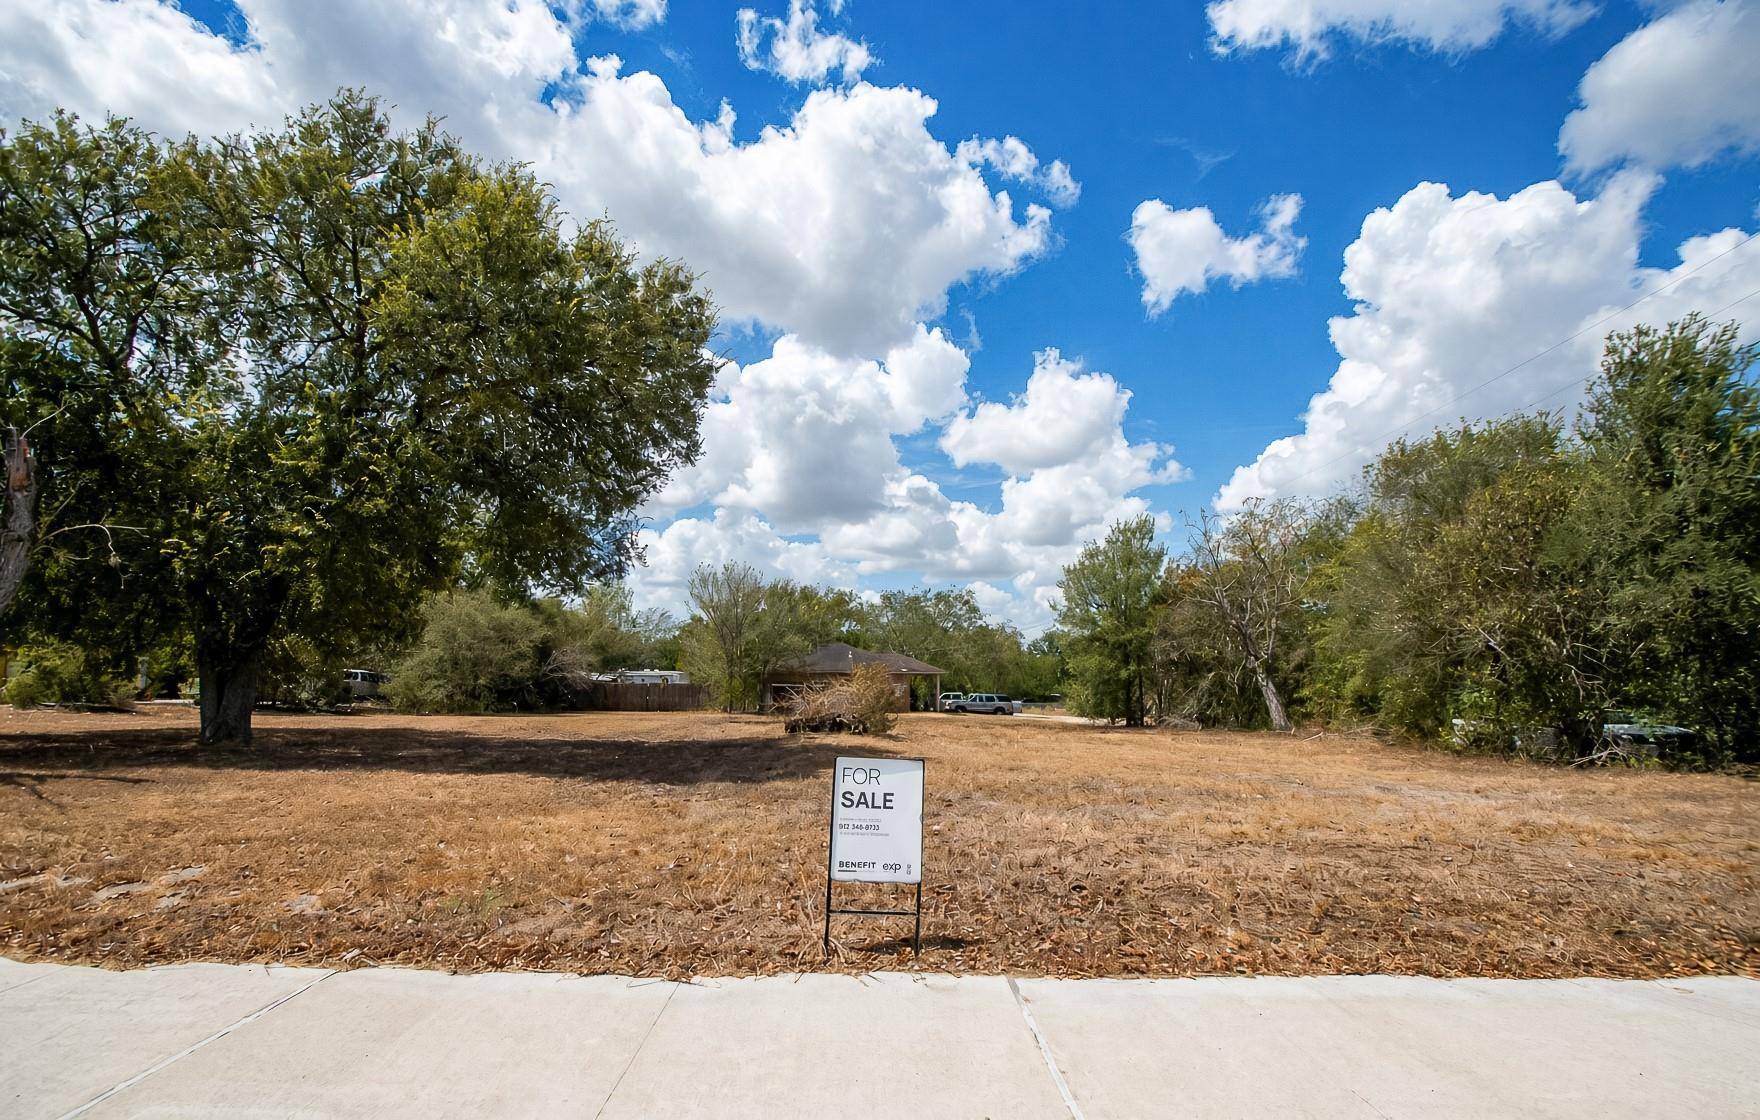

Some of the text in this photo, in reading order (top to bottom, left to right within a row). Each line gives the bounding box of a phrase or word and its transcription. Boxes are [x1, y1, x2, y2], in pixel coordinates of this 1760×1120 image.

[842, 767, 881, 786] FOR
[841, 790, 895, 810] SALE
[838, 860, 902, 874] BENEFIT exp
